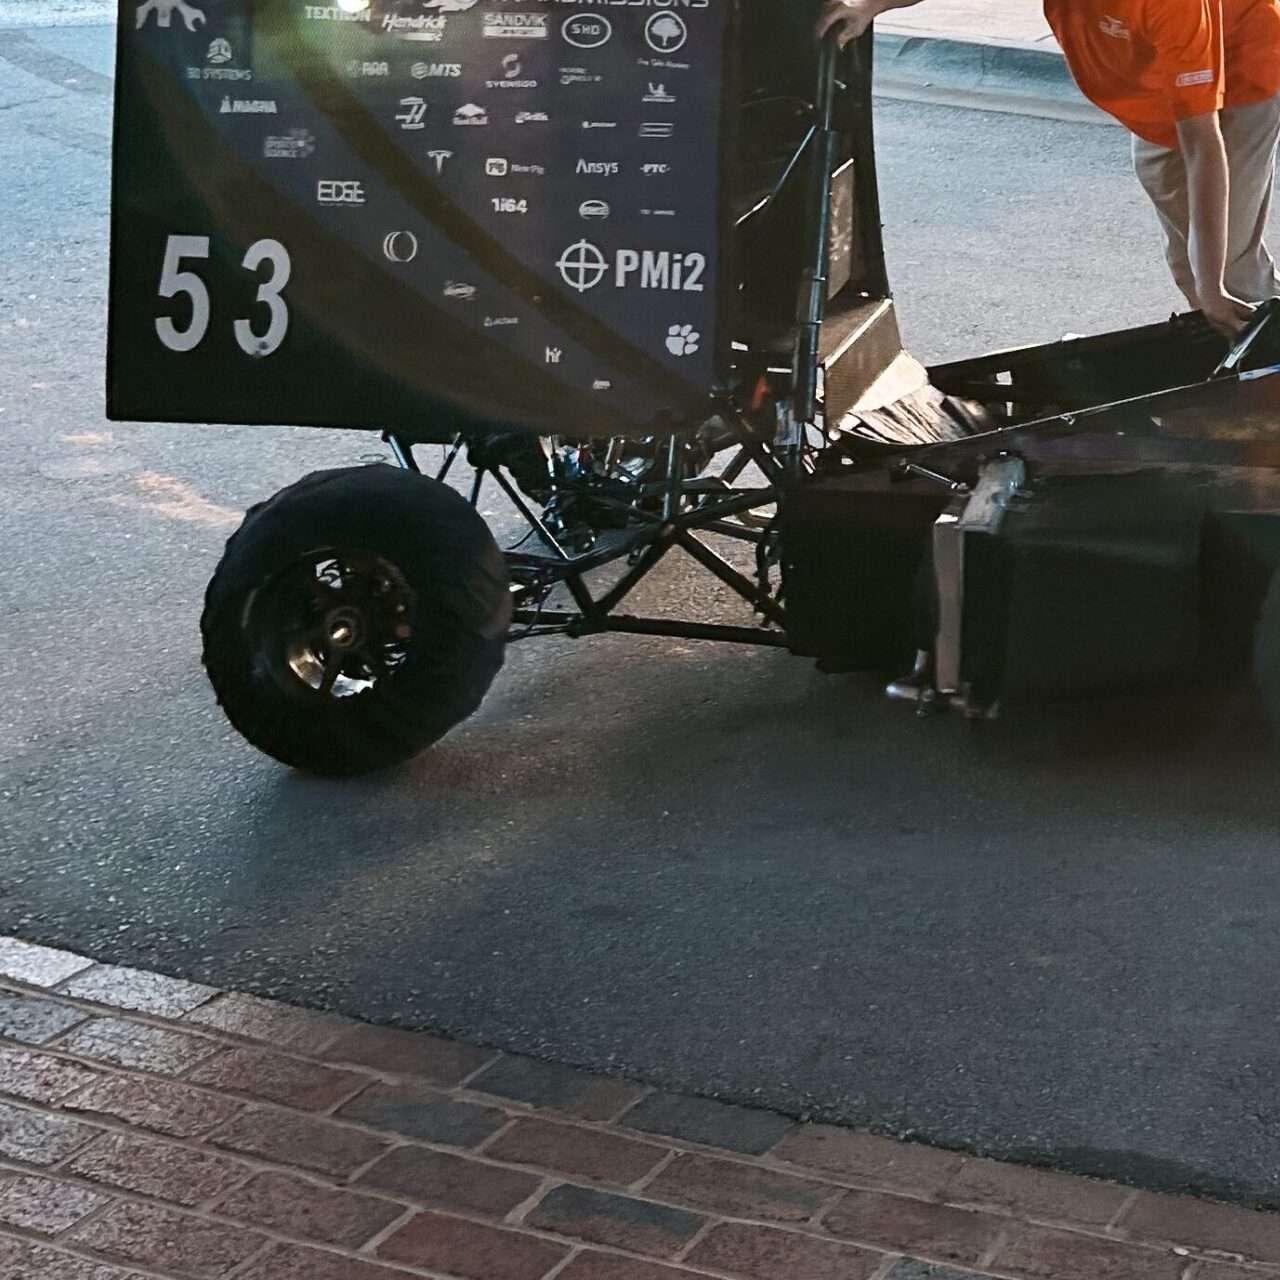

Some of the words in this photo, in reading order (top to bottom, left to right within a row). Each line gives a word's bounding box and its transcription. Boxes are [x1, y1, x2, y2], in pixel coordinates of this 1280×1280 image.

[427, 63, 461, 78] MTS
[576, 158, 619, 177] Ansys
[615, 249, 706, 292] PMi2
